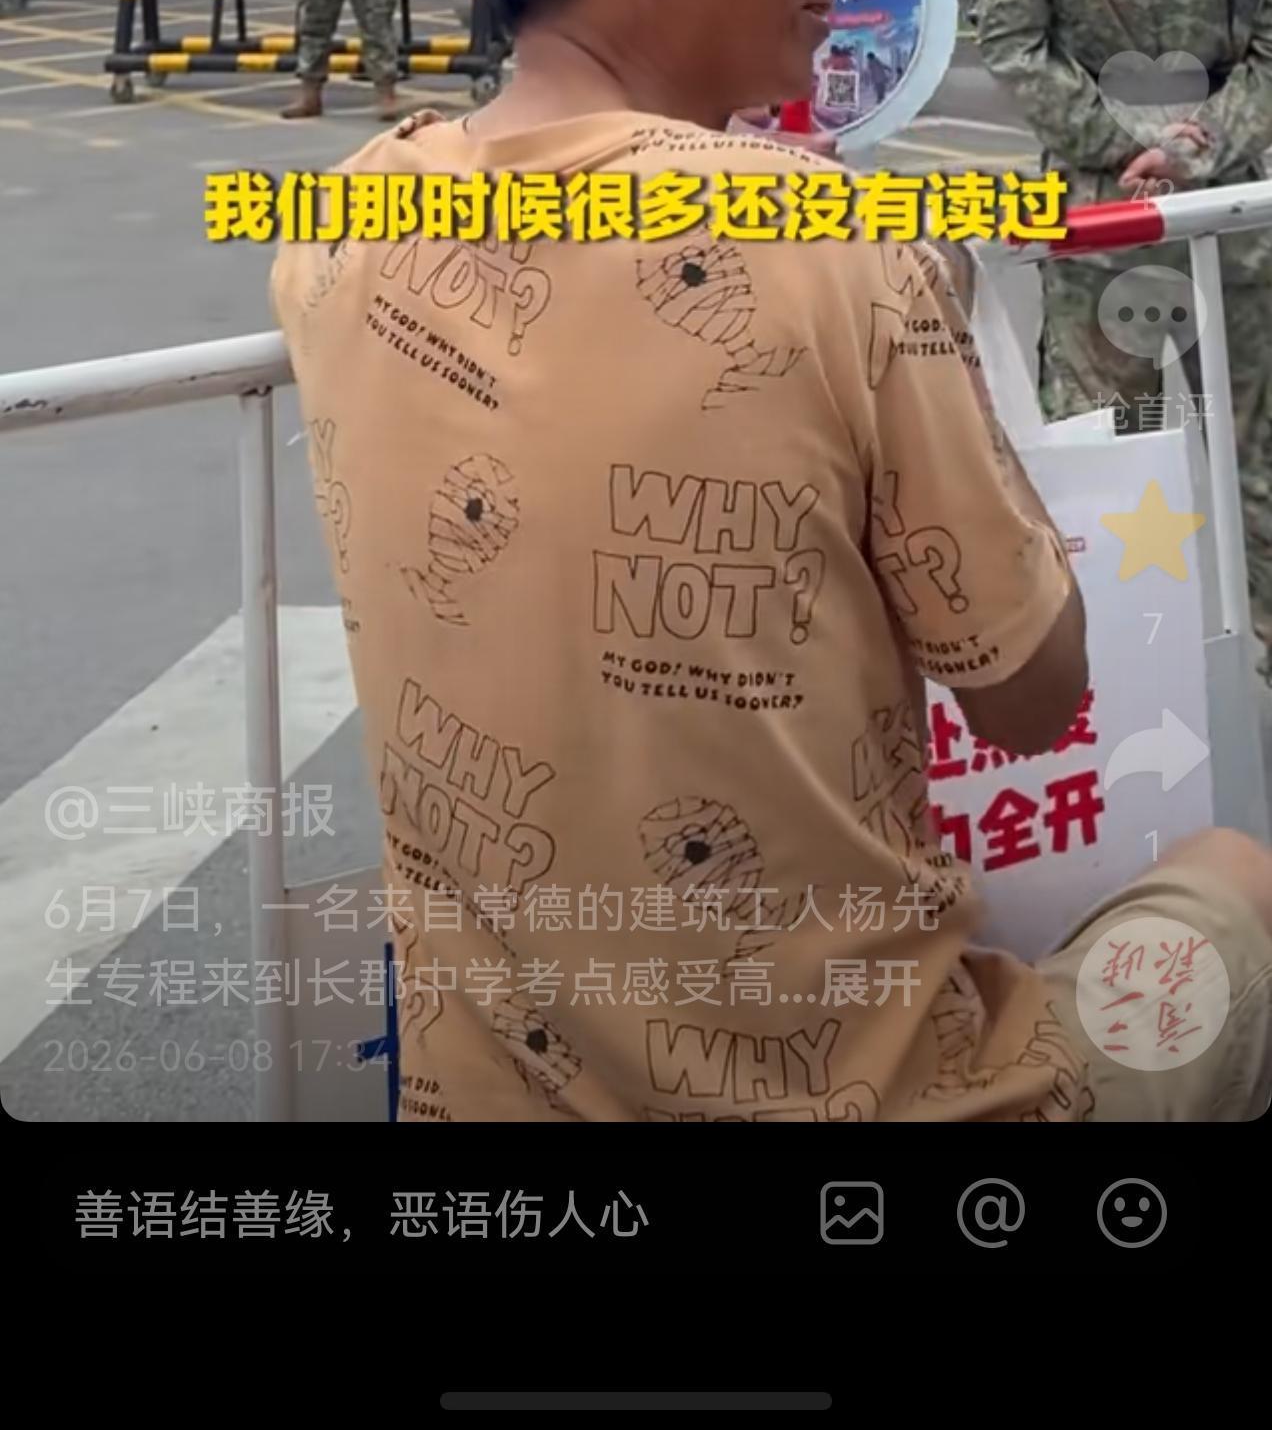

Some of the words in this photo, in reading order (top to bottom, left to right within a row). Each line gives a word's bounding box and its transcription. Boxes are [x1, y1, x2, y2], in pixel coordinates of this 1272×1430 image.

[365, 312, 387, 338] YOU
[386, 331, 418, 360] TELL
[419, 353, 442, 373] US
[440, 366, 500, 412] SOONER?
[374, 294, 392, 314] MY
[390, 308, 426, 337] GOD!
[426, 331, 457, 358] WHY
[609, 464, 821, 554] WHY
[592, 548, 826, 646] NOT?
[601, 670, 635, 694] YOU
[641, 683, 689, 698] TELL
[695, 685, 718, 701] US
[725, 693, 804, 711] SOONER?
[602, 650, 626, 668] MY
[631, 659, 683, 676] GOD!
[688, 665, 732, 686] WHY
[737, 672, 796, 687] DIDN'T
[396, 677, 557, 820] WHY
[380, 742, 557, 912] NOT?
[646, 1018, 842, 1104] WHY
